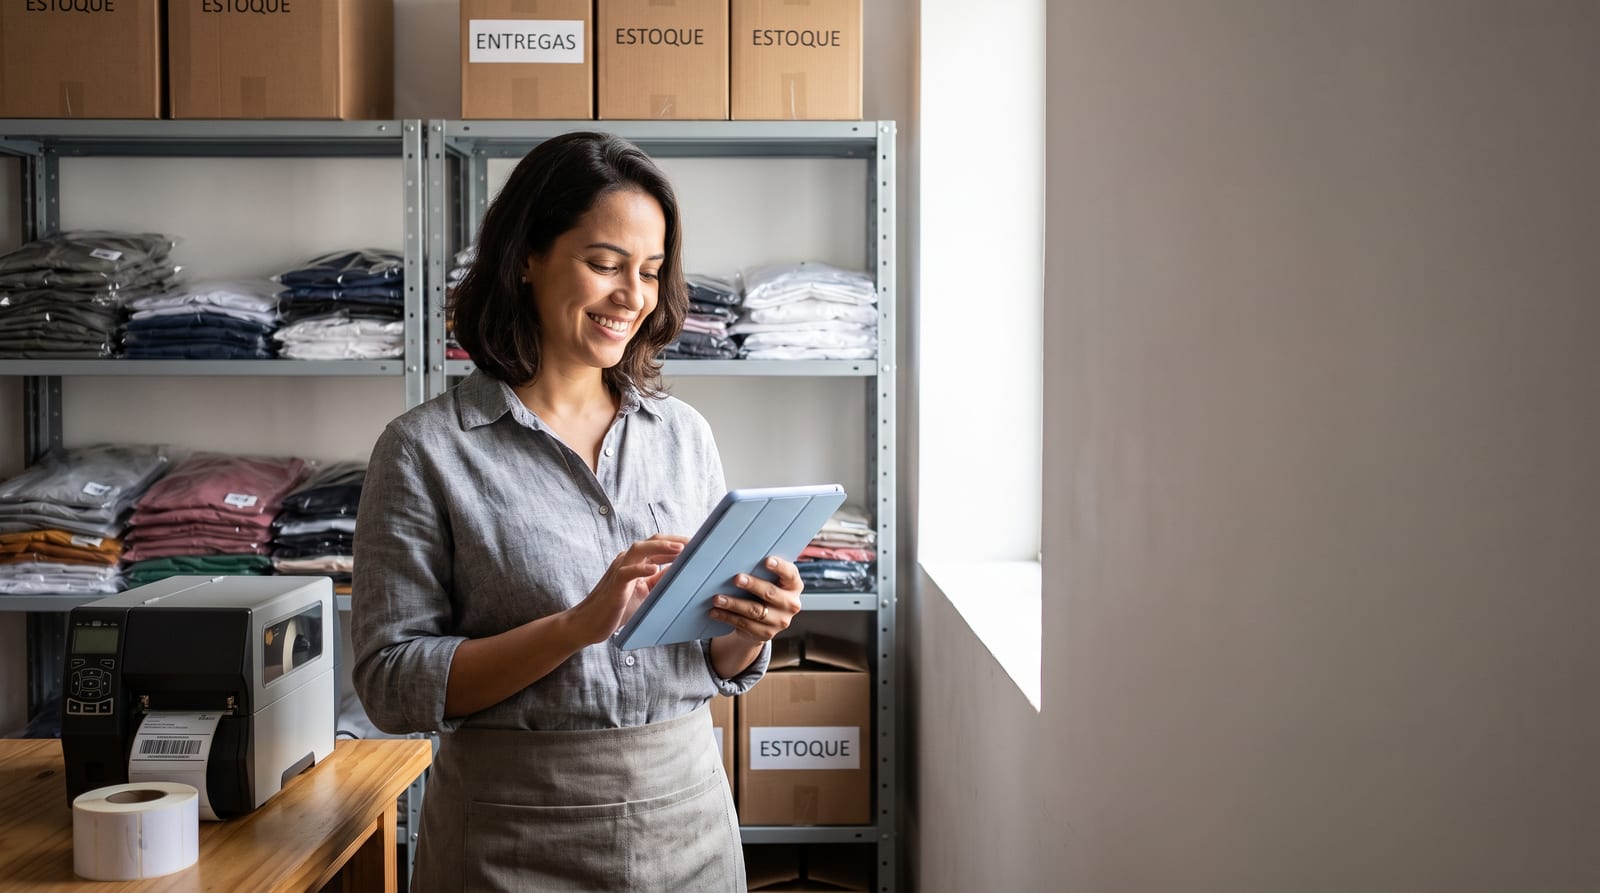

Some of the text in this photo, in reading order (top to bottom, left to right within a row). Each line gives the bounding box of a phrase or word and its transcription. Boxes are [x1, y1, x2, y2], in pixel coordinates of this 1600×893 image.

[26, 0, 115, 13] ESTOQUE
[202, 0, 291, 15] ESTOQUE
[476, 33, 577, 50] ENTREGAS
[615, 28, 705, 47] ESTOQUE
[752, 30, 841, 48] ESTOQUE
[760, 740, 850, 758] ESTOQUE
